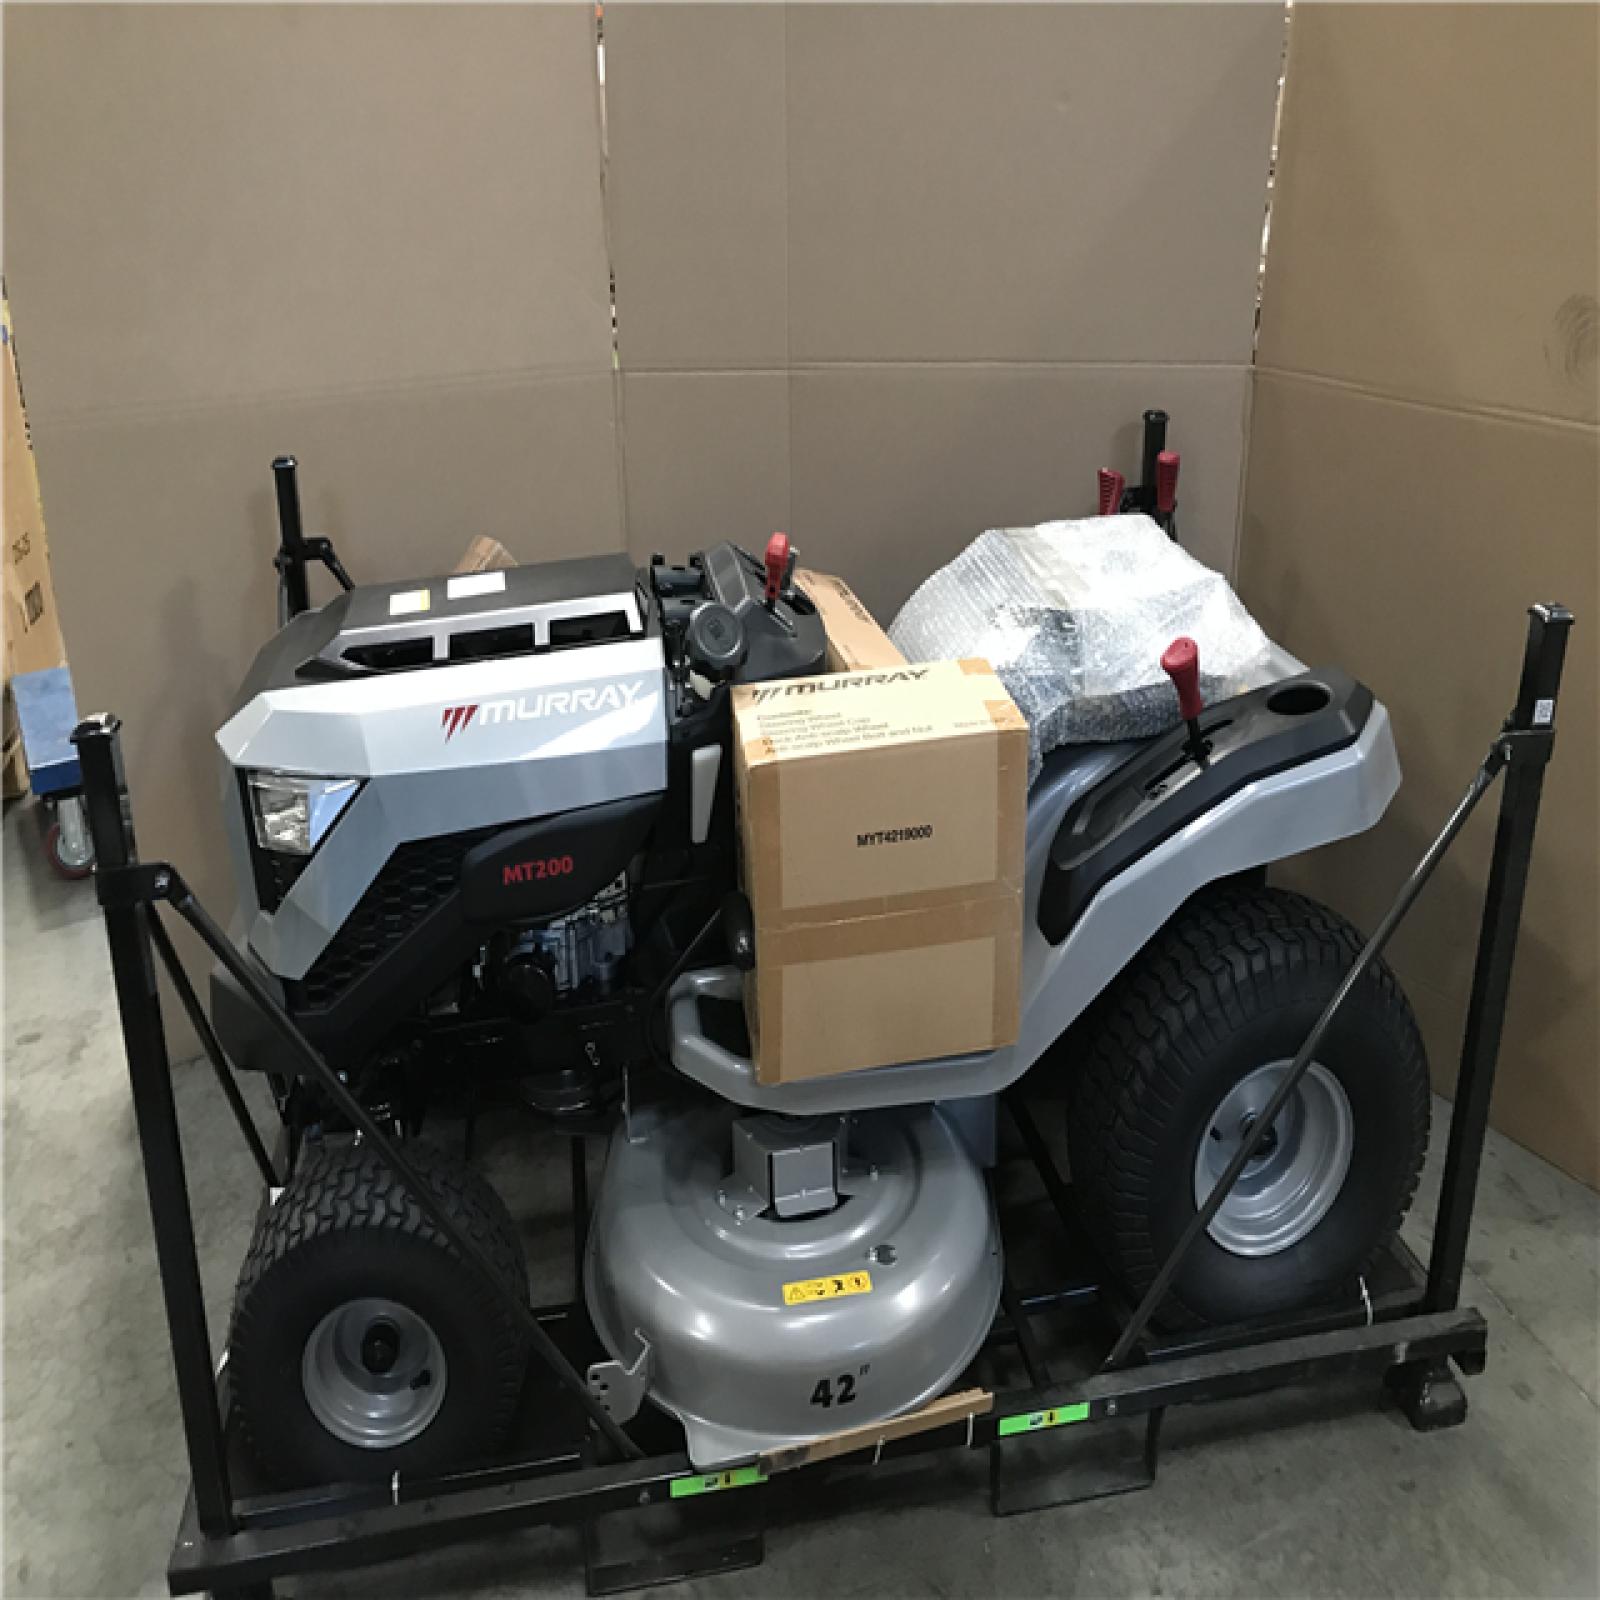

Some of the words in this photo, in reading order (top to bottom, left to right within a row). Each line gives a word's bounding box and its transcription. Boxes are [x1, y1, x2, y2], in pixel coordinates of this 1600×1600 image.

[785, 668, 927, 695] MURRAY
[479, 680, 642, 725] MURRAY
[502, 855, 574, 886] MT200
